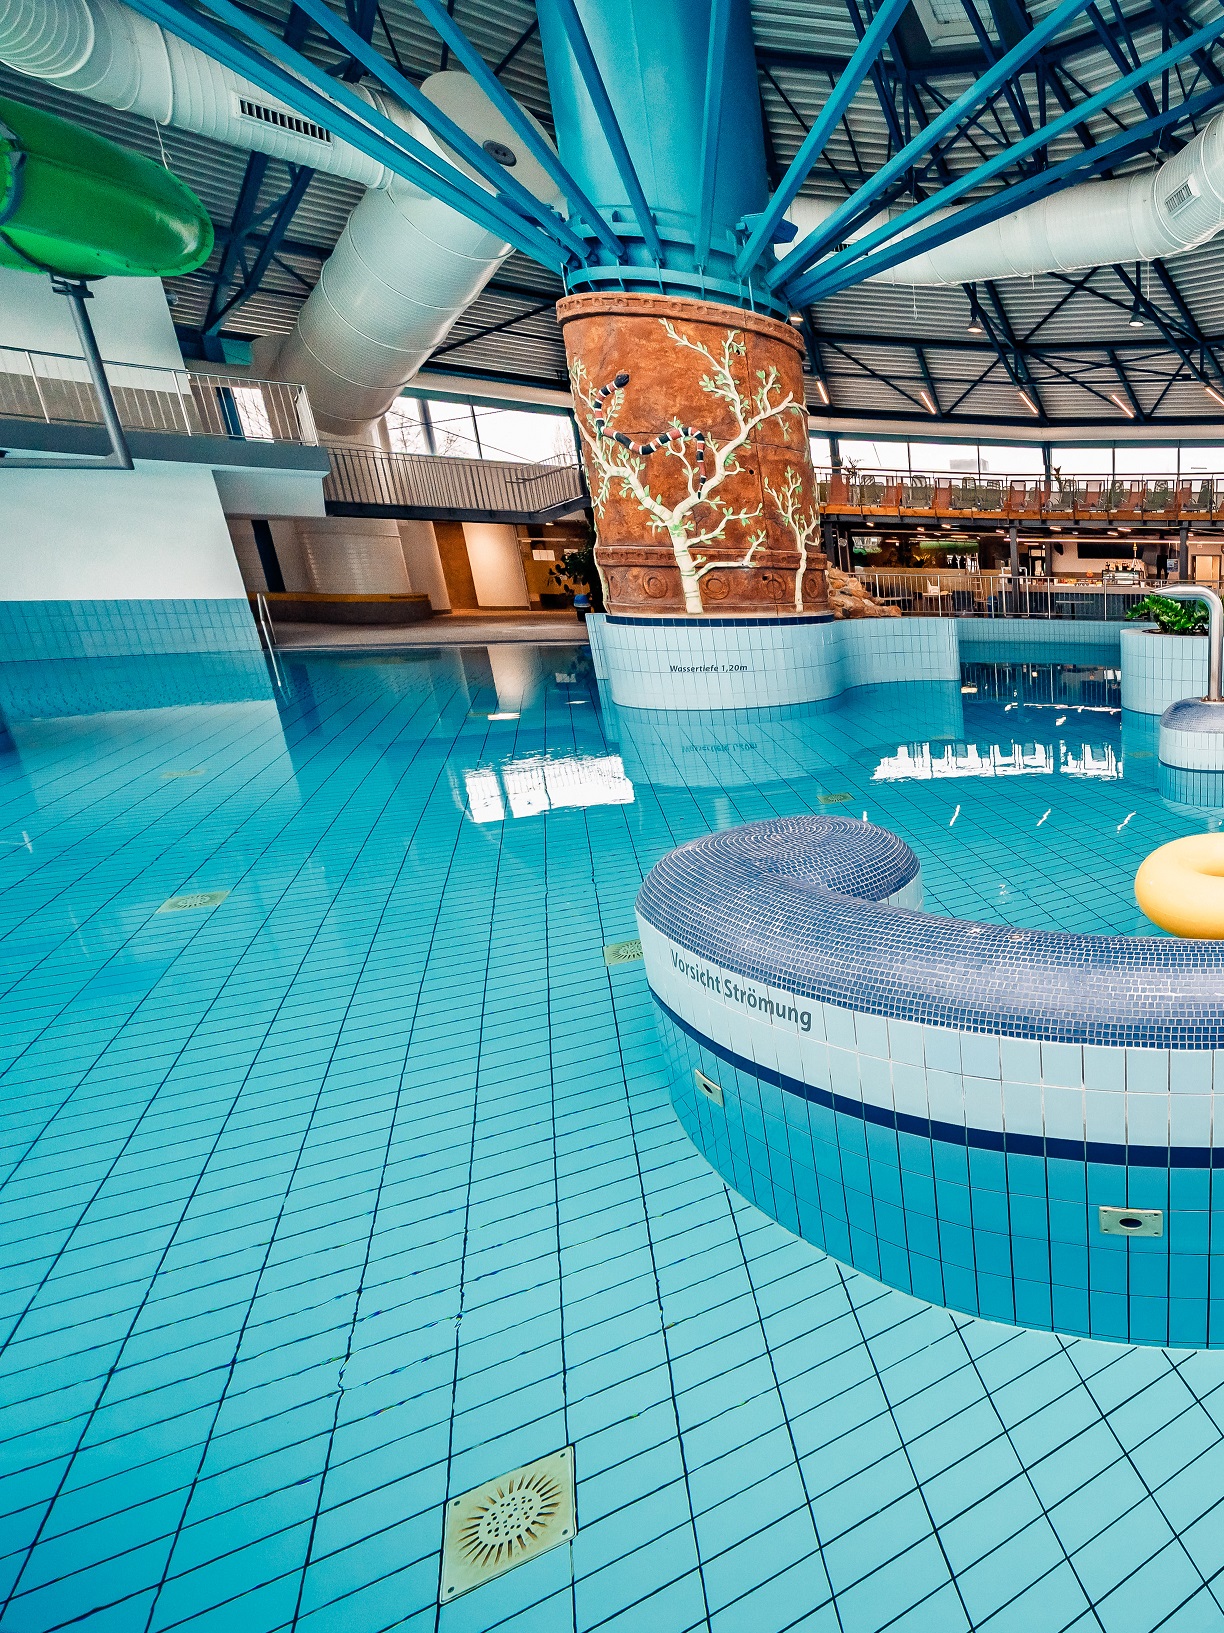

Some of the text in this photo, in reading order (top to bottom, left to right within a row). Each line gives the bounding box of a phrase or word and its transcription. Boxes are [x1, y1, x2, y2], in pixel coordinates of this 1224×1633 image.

[669, 664, 748, 673] Wassertiefe 1,20m
[671, 948, 812, 1032] Vorsicht Strömung
